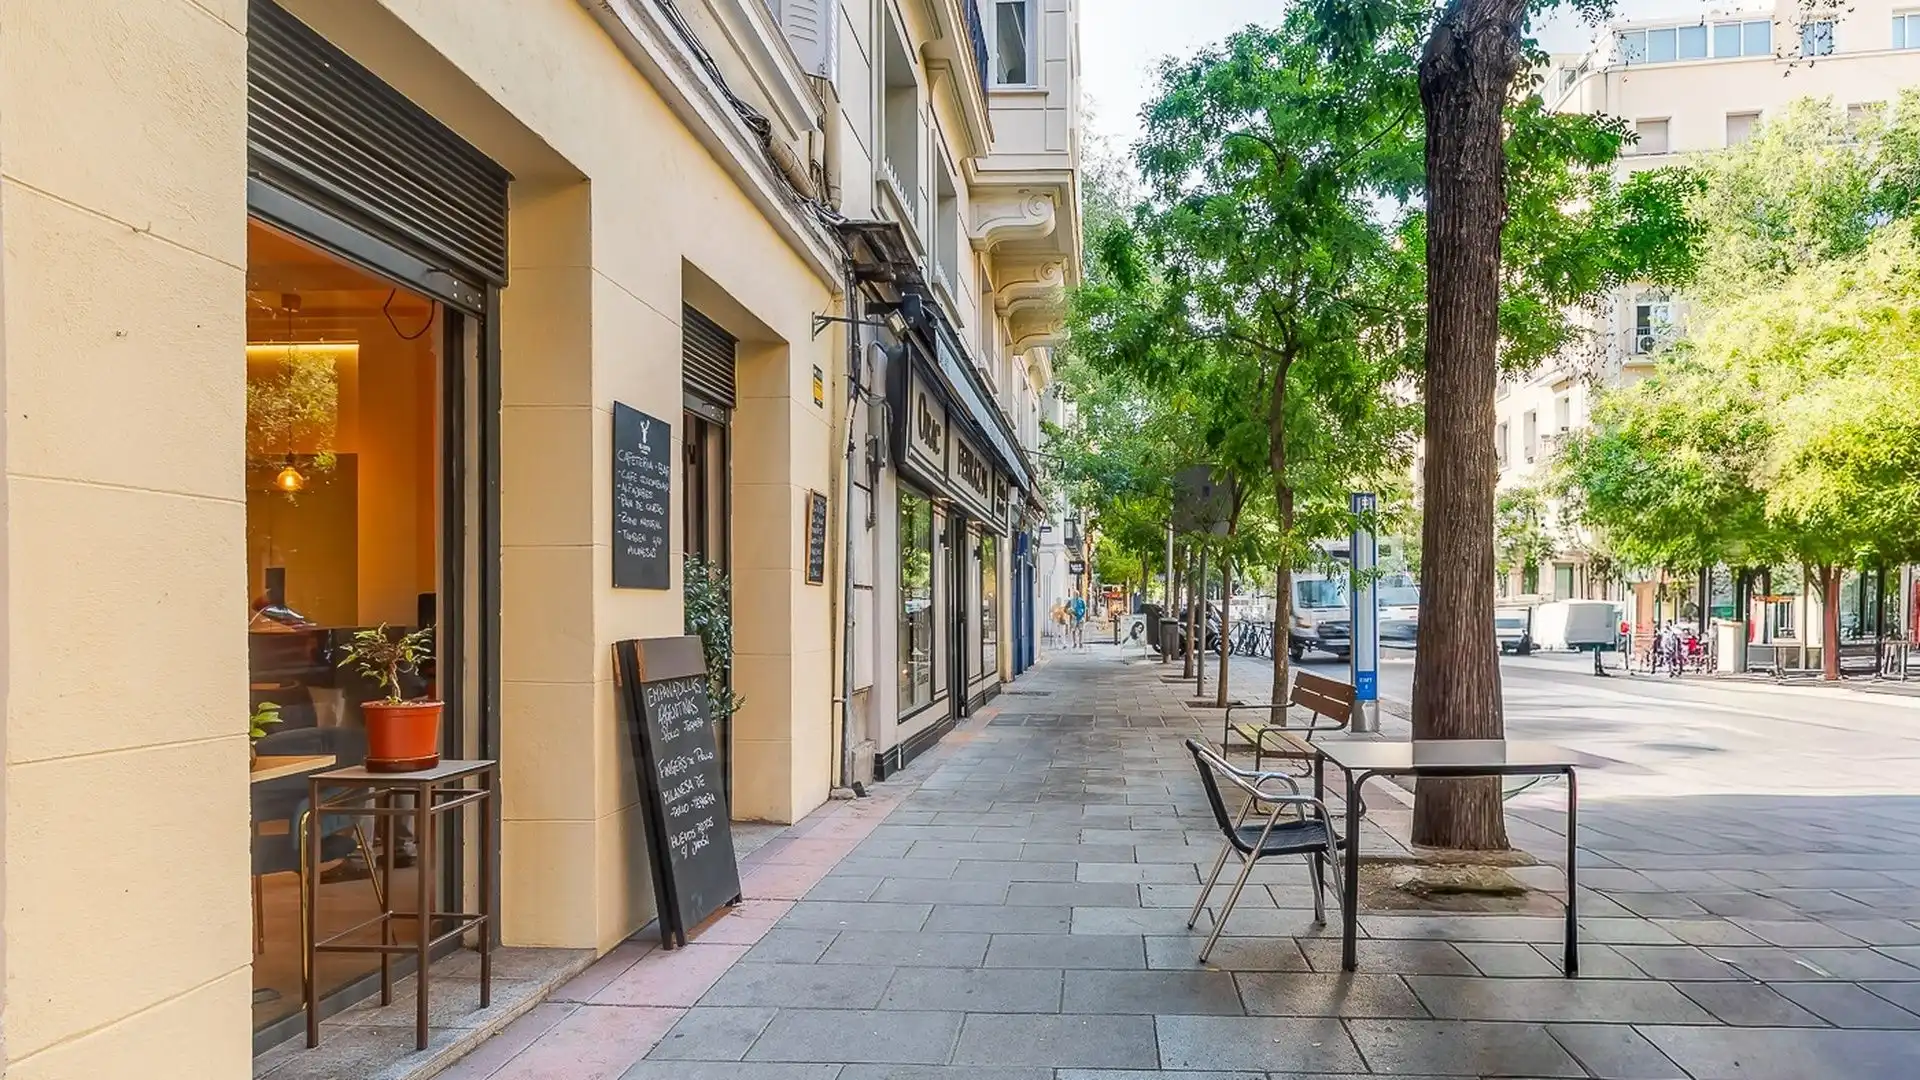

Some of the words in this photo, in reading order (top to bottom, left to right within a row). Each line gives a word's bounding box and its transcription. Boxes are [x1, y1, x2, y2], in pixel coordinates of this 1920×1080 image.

[661, 779, 695, 805] MILANESA
[694, 773, 706, 788] DE
[670, 829, 696, 849] HUEVOS
